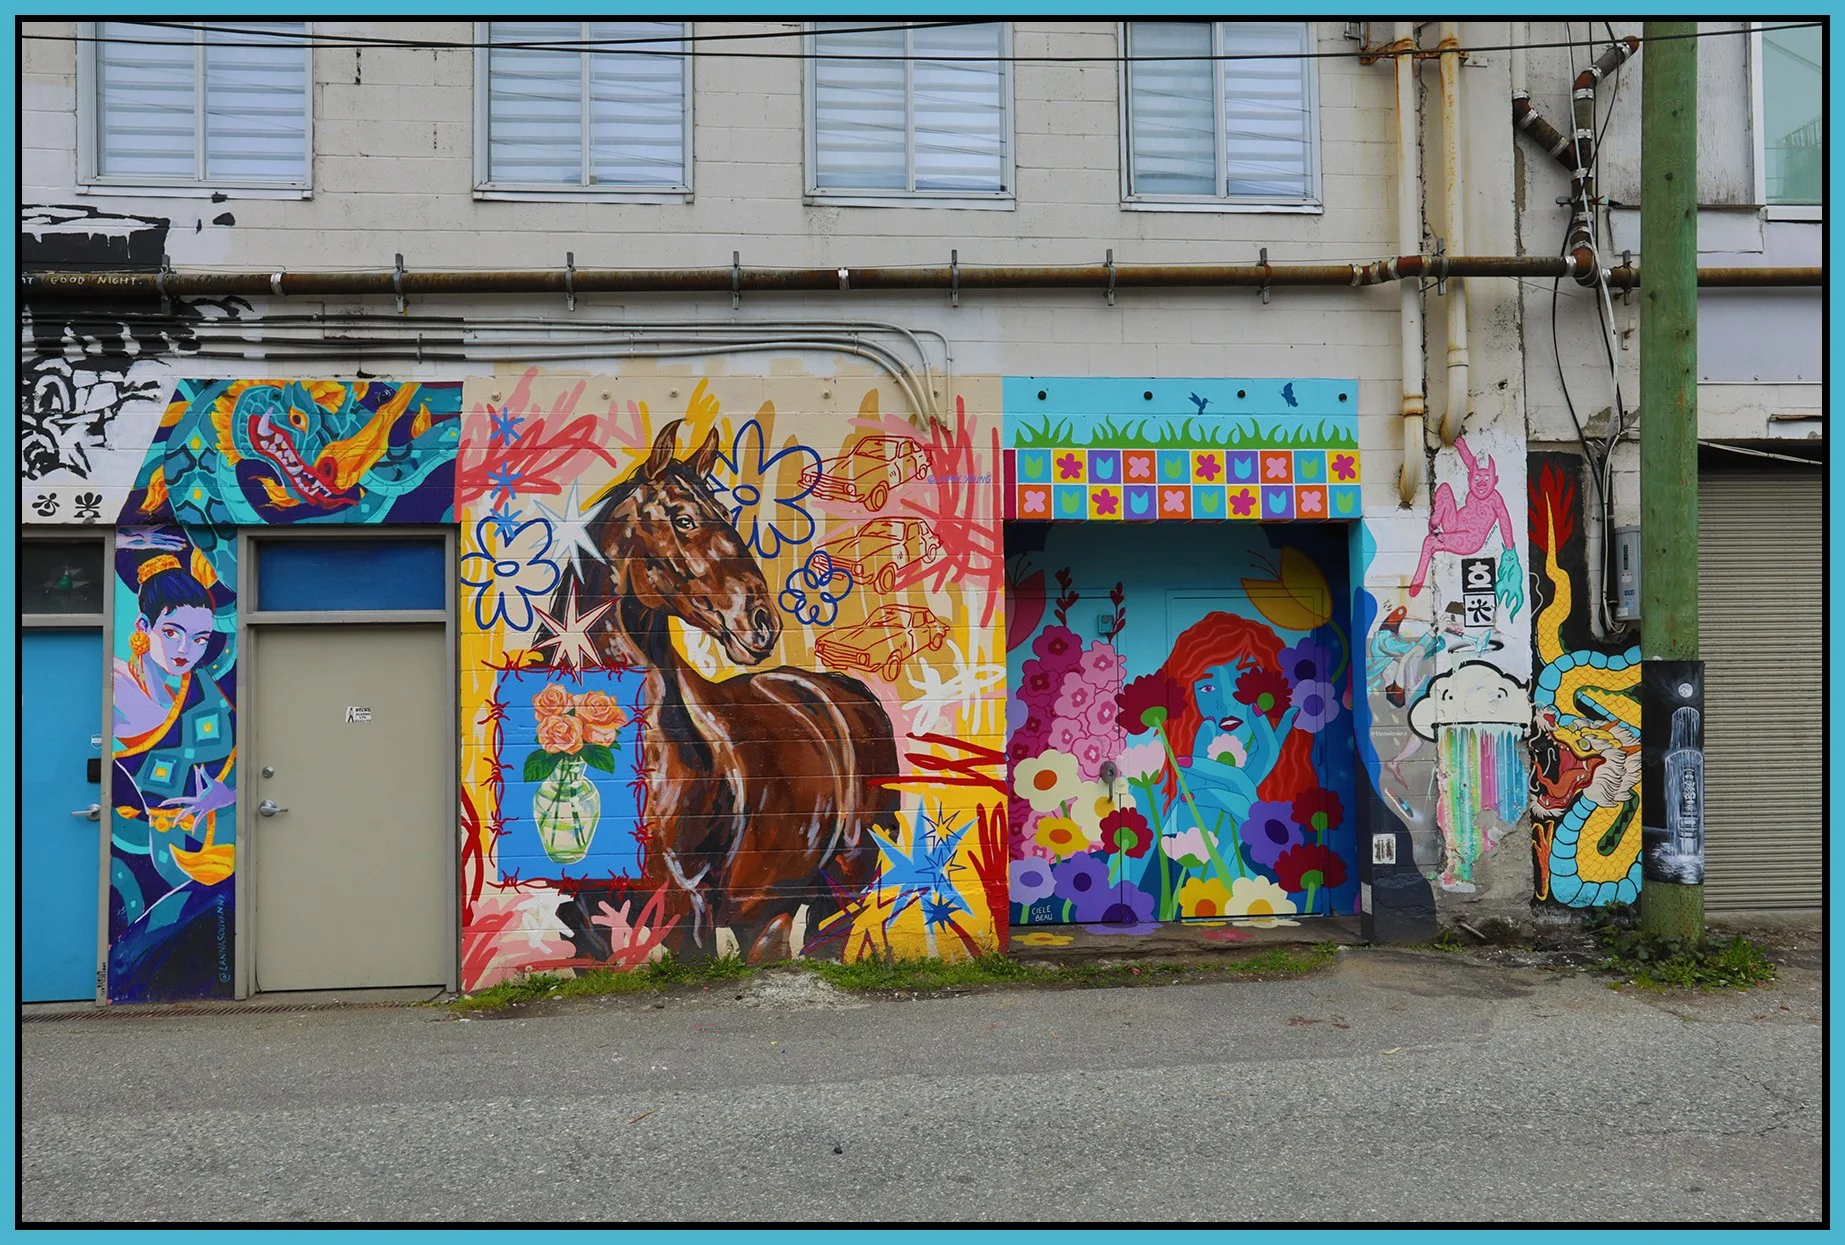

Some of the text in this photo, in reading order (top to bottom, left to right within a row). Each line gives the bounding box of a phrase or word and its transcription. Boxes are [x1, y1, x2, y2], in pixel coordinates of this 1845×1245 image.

[50, 276, 85, 285] GOOD
[97, 276, 142, 286] NIGHT.
[1031, 904, 1051, 915] CIELE
[1035, 913, 1053, 922] BEAU
